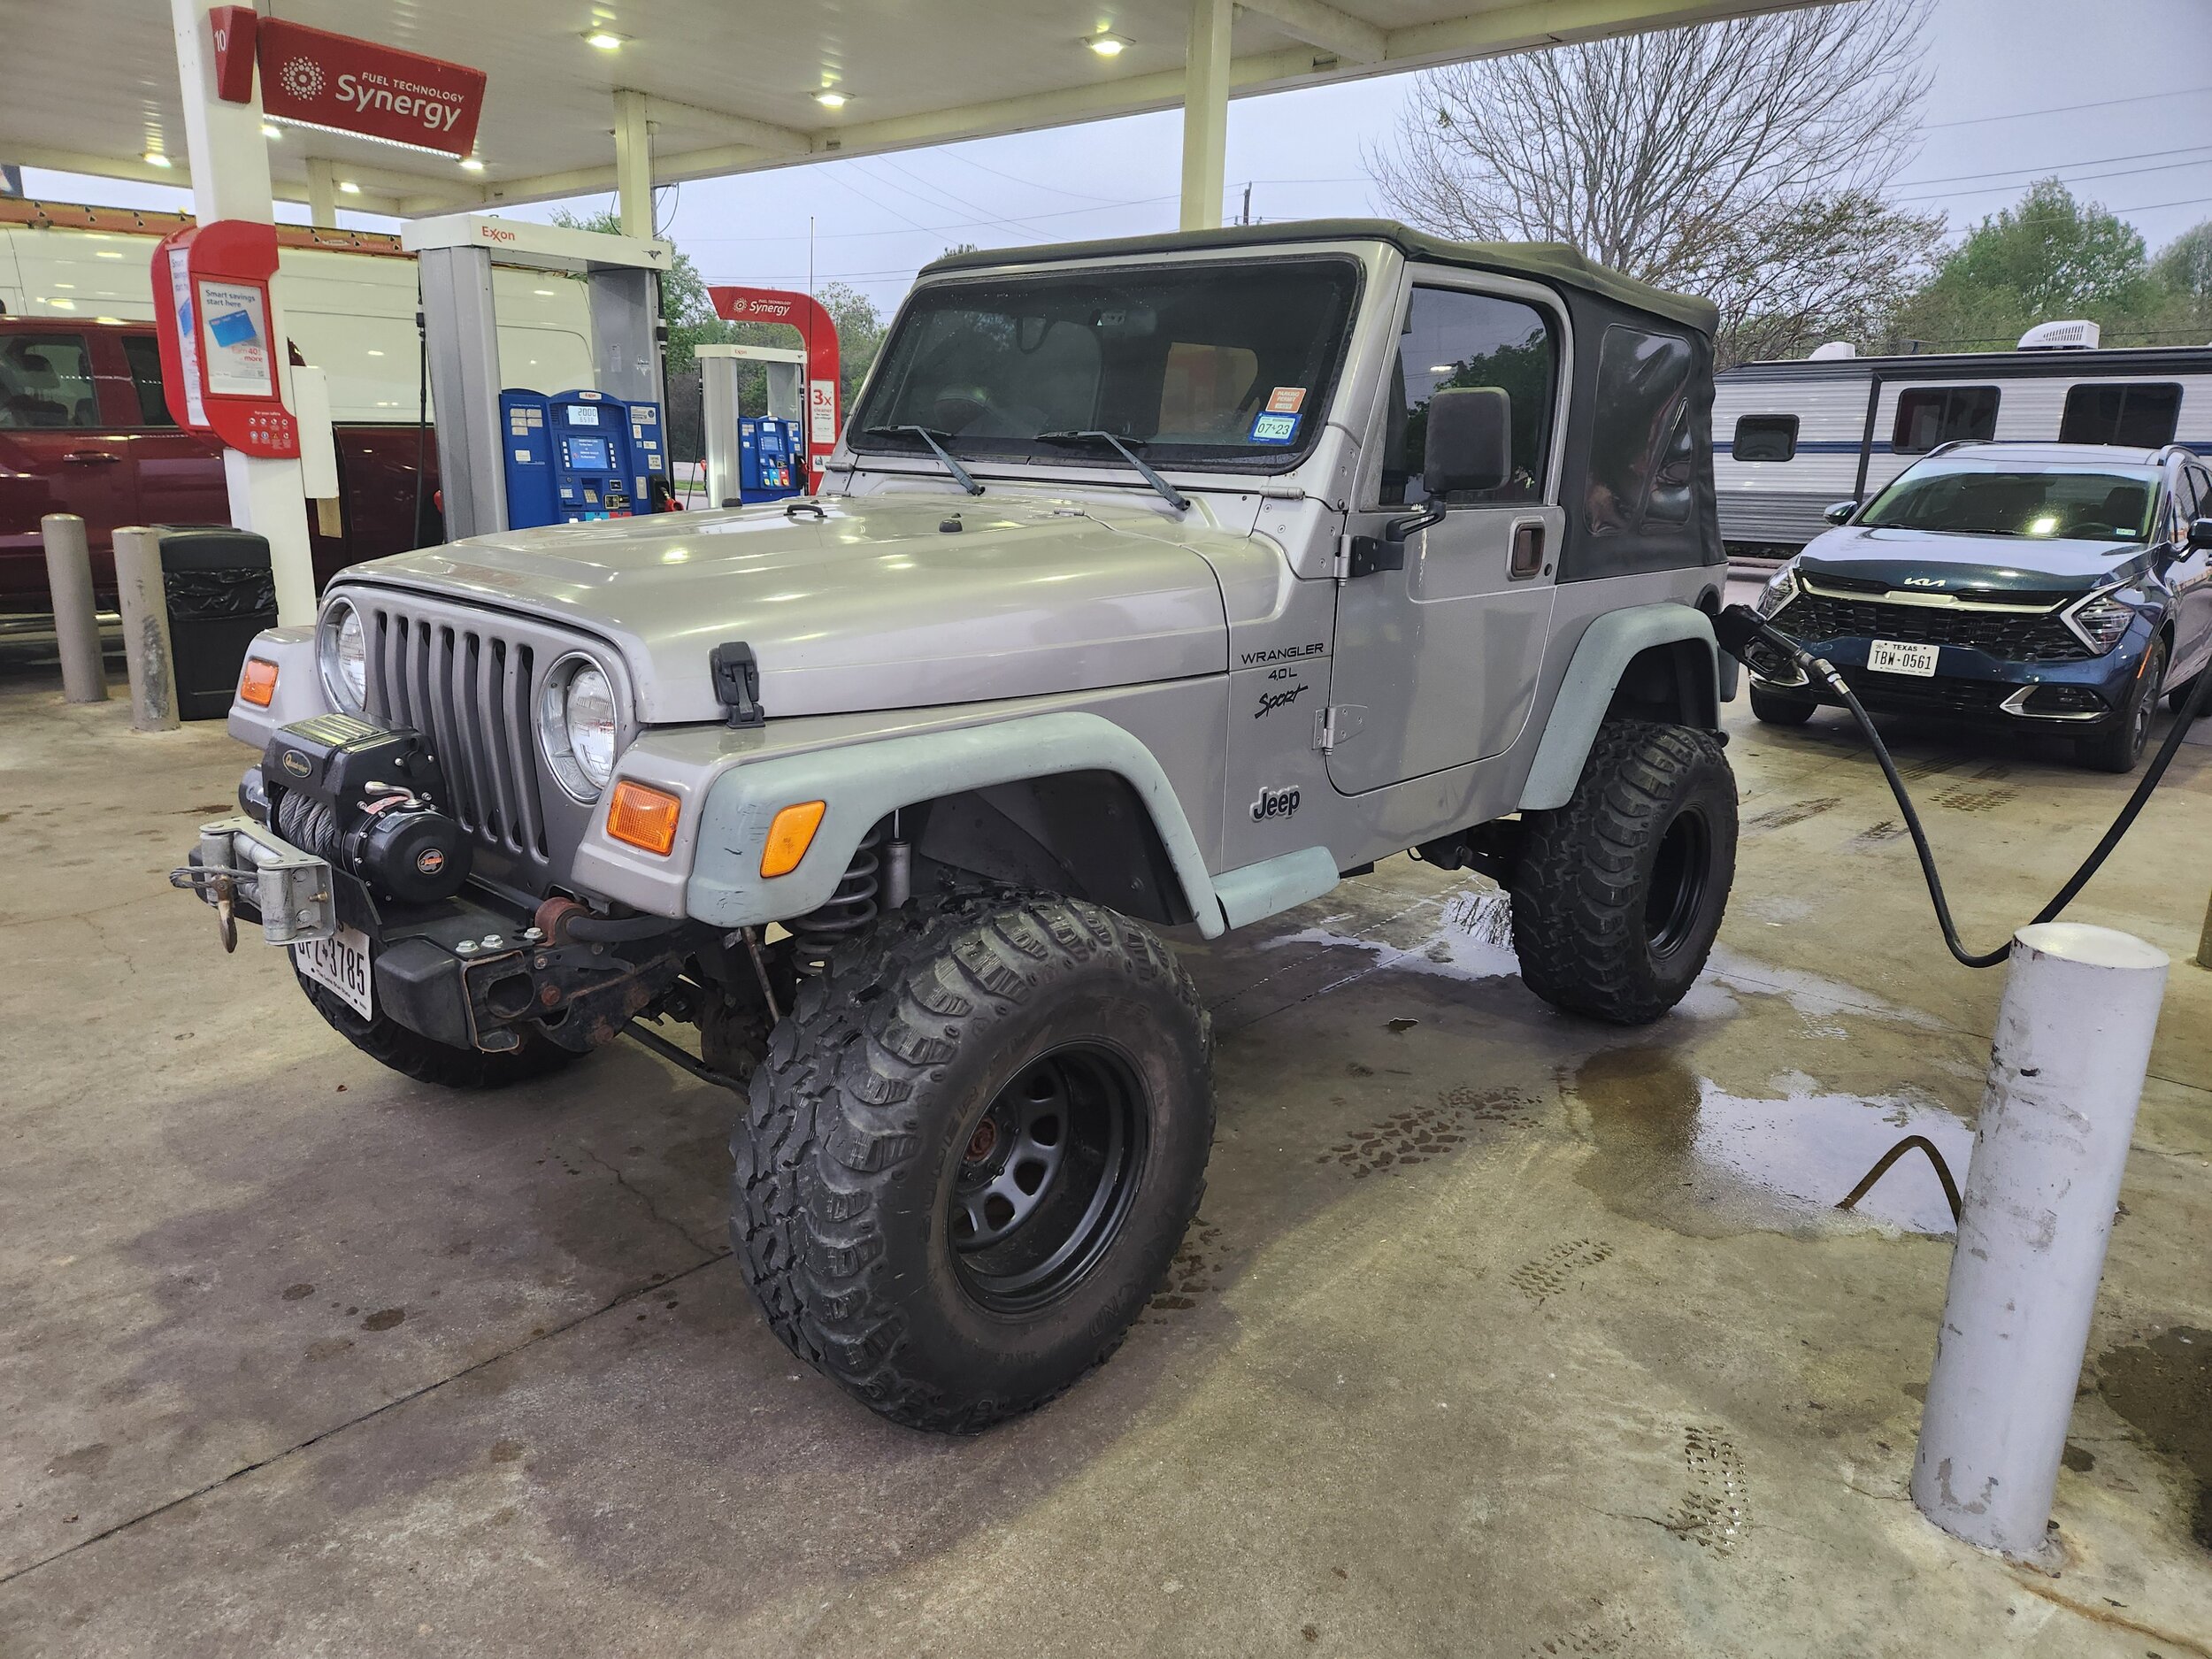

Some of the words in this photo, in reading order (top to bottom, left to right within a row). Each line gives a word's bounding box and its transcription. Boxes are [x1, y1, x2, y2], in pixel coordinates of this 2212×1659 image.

[214, 28, 227, 52] 10
[361, 72, 389, 87] FUEL
[393, 79, 465, 104] TECHNOLOGY
[335, 74, 461, 132] Synergy
[481, 226, 516, 243] Exxon
[205, 289, 227, 298] Smart
[229, 293, 256, 303] savings
[749, 301, 790, 317] Synergy
[1240, 642, 1325, 664] WRANGLER
[1893, 643, 1918, 652] TEXAS
[1255, 683, 1309, 719] Sport
[1250, 787, 1301, 821] Jeep
